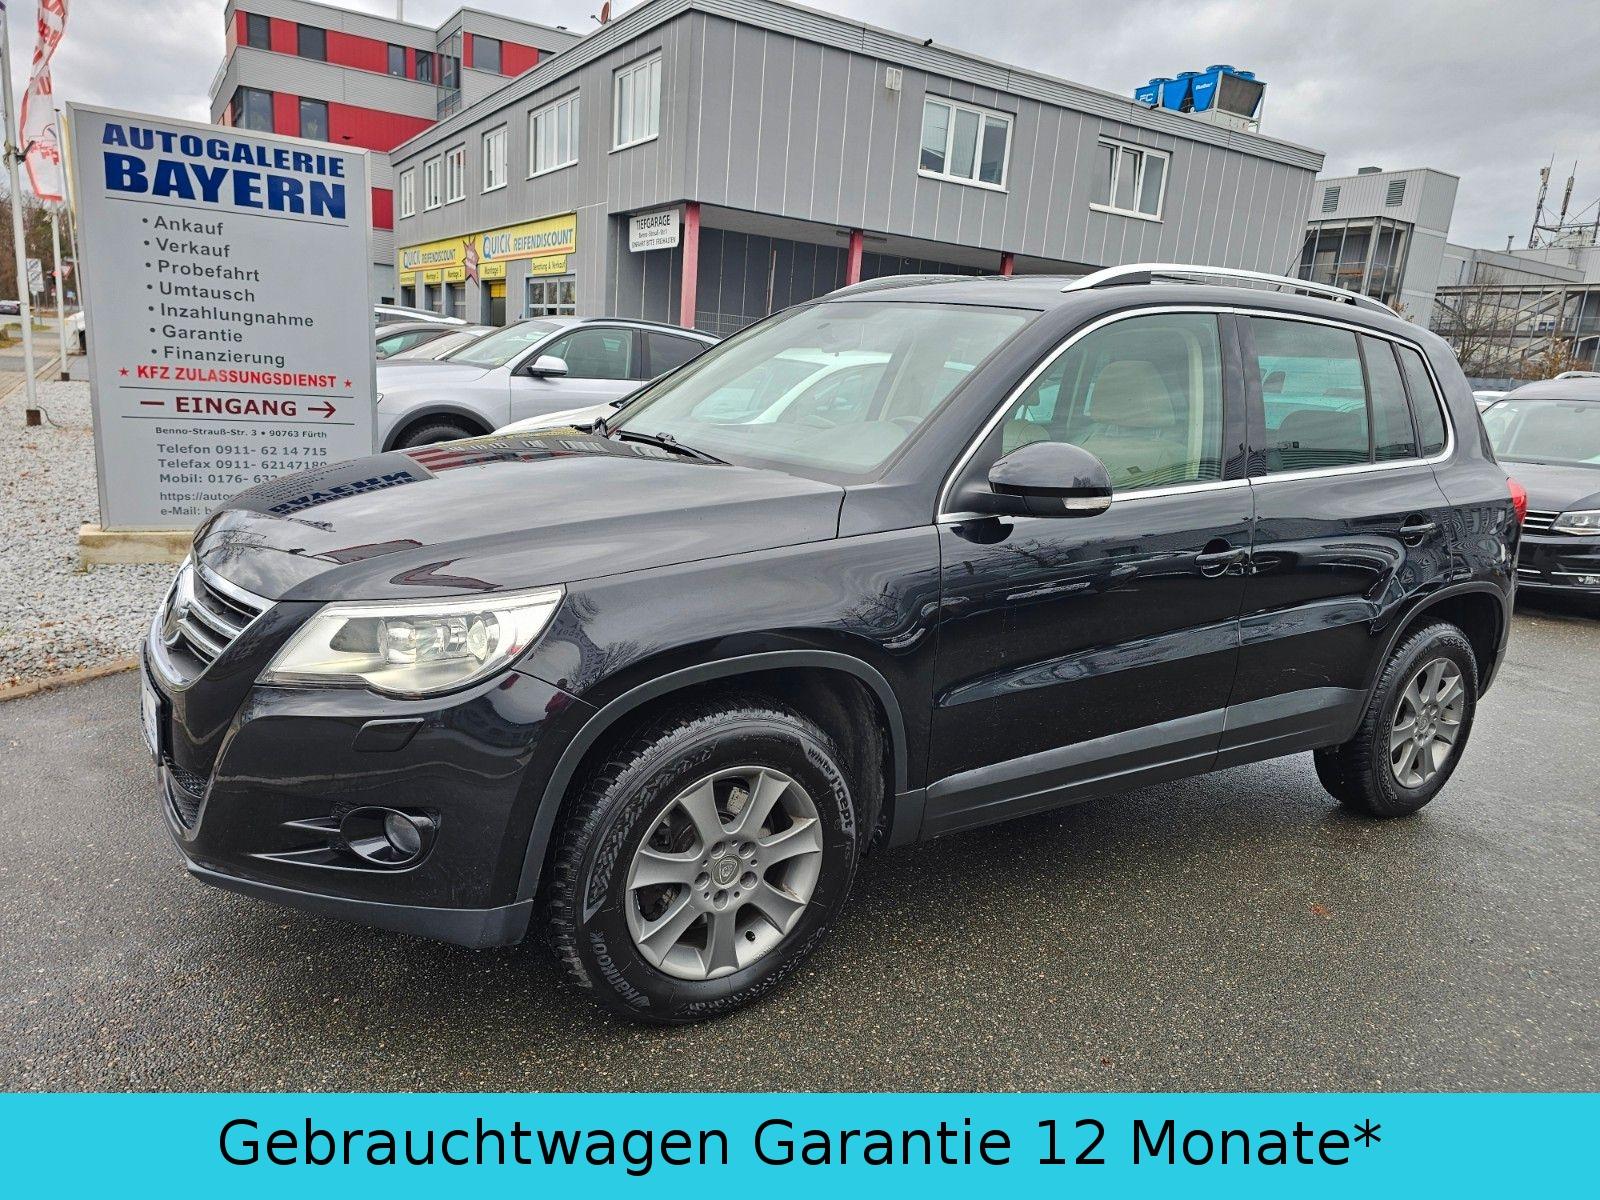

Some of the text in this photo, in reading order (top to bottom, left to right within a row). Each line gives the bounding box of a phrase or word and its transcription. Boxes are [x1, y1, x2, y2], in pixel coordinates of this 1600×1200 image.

[102, 123, 345, 178] AUTOGALERIE
[103, 151, 346, 219] BAYERN
[154, 216, 224, 236] Ankauf
[636, 215, 670, 230] TIEFGARAGE
[155, 237, 230, 258] Verkauf
[483, 233, 511, 260] QUICK
[513, 228, 574, 251] REIFENDISCOUNT
[158, 259, 260, 282] Probefahrt
[159, 282, 255, 302] Umtausch
[160, 302, 314, 328] Inzahlungnahme
[162, 326, 243, 342] Garantie
[164, 346, 286, 368] Finanzierung
[137, 365, 338, 388] KFZ ZULASSUNGSDIENST
[176, 396, 297, 416] EINGANG
[155, 427, 248, 437] Benno-Strauß-Str.
[302, 430, 327, 438] Fürth
[157, 444, 327, 456] Telefon 0911- 62 14 715
[158, 459, 211, 469] Telefax
[216, 460, 256, 469] 0911-
[160, 474, 202, 483] Mobil:
[208, 474, 248, 484] 0176-
[161, 507, 200, 516] e-Mail:
